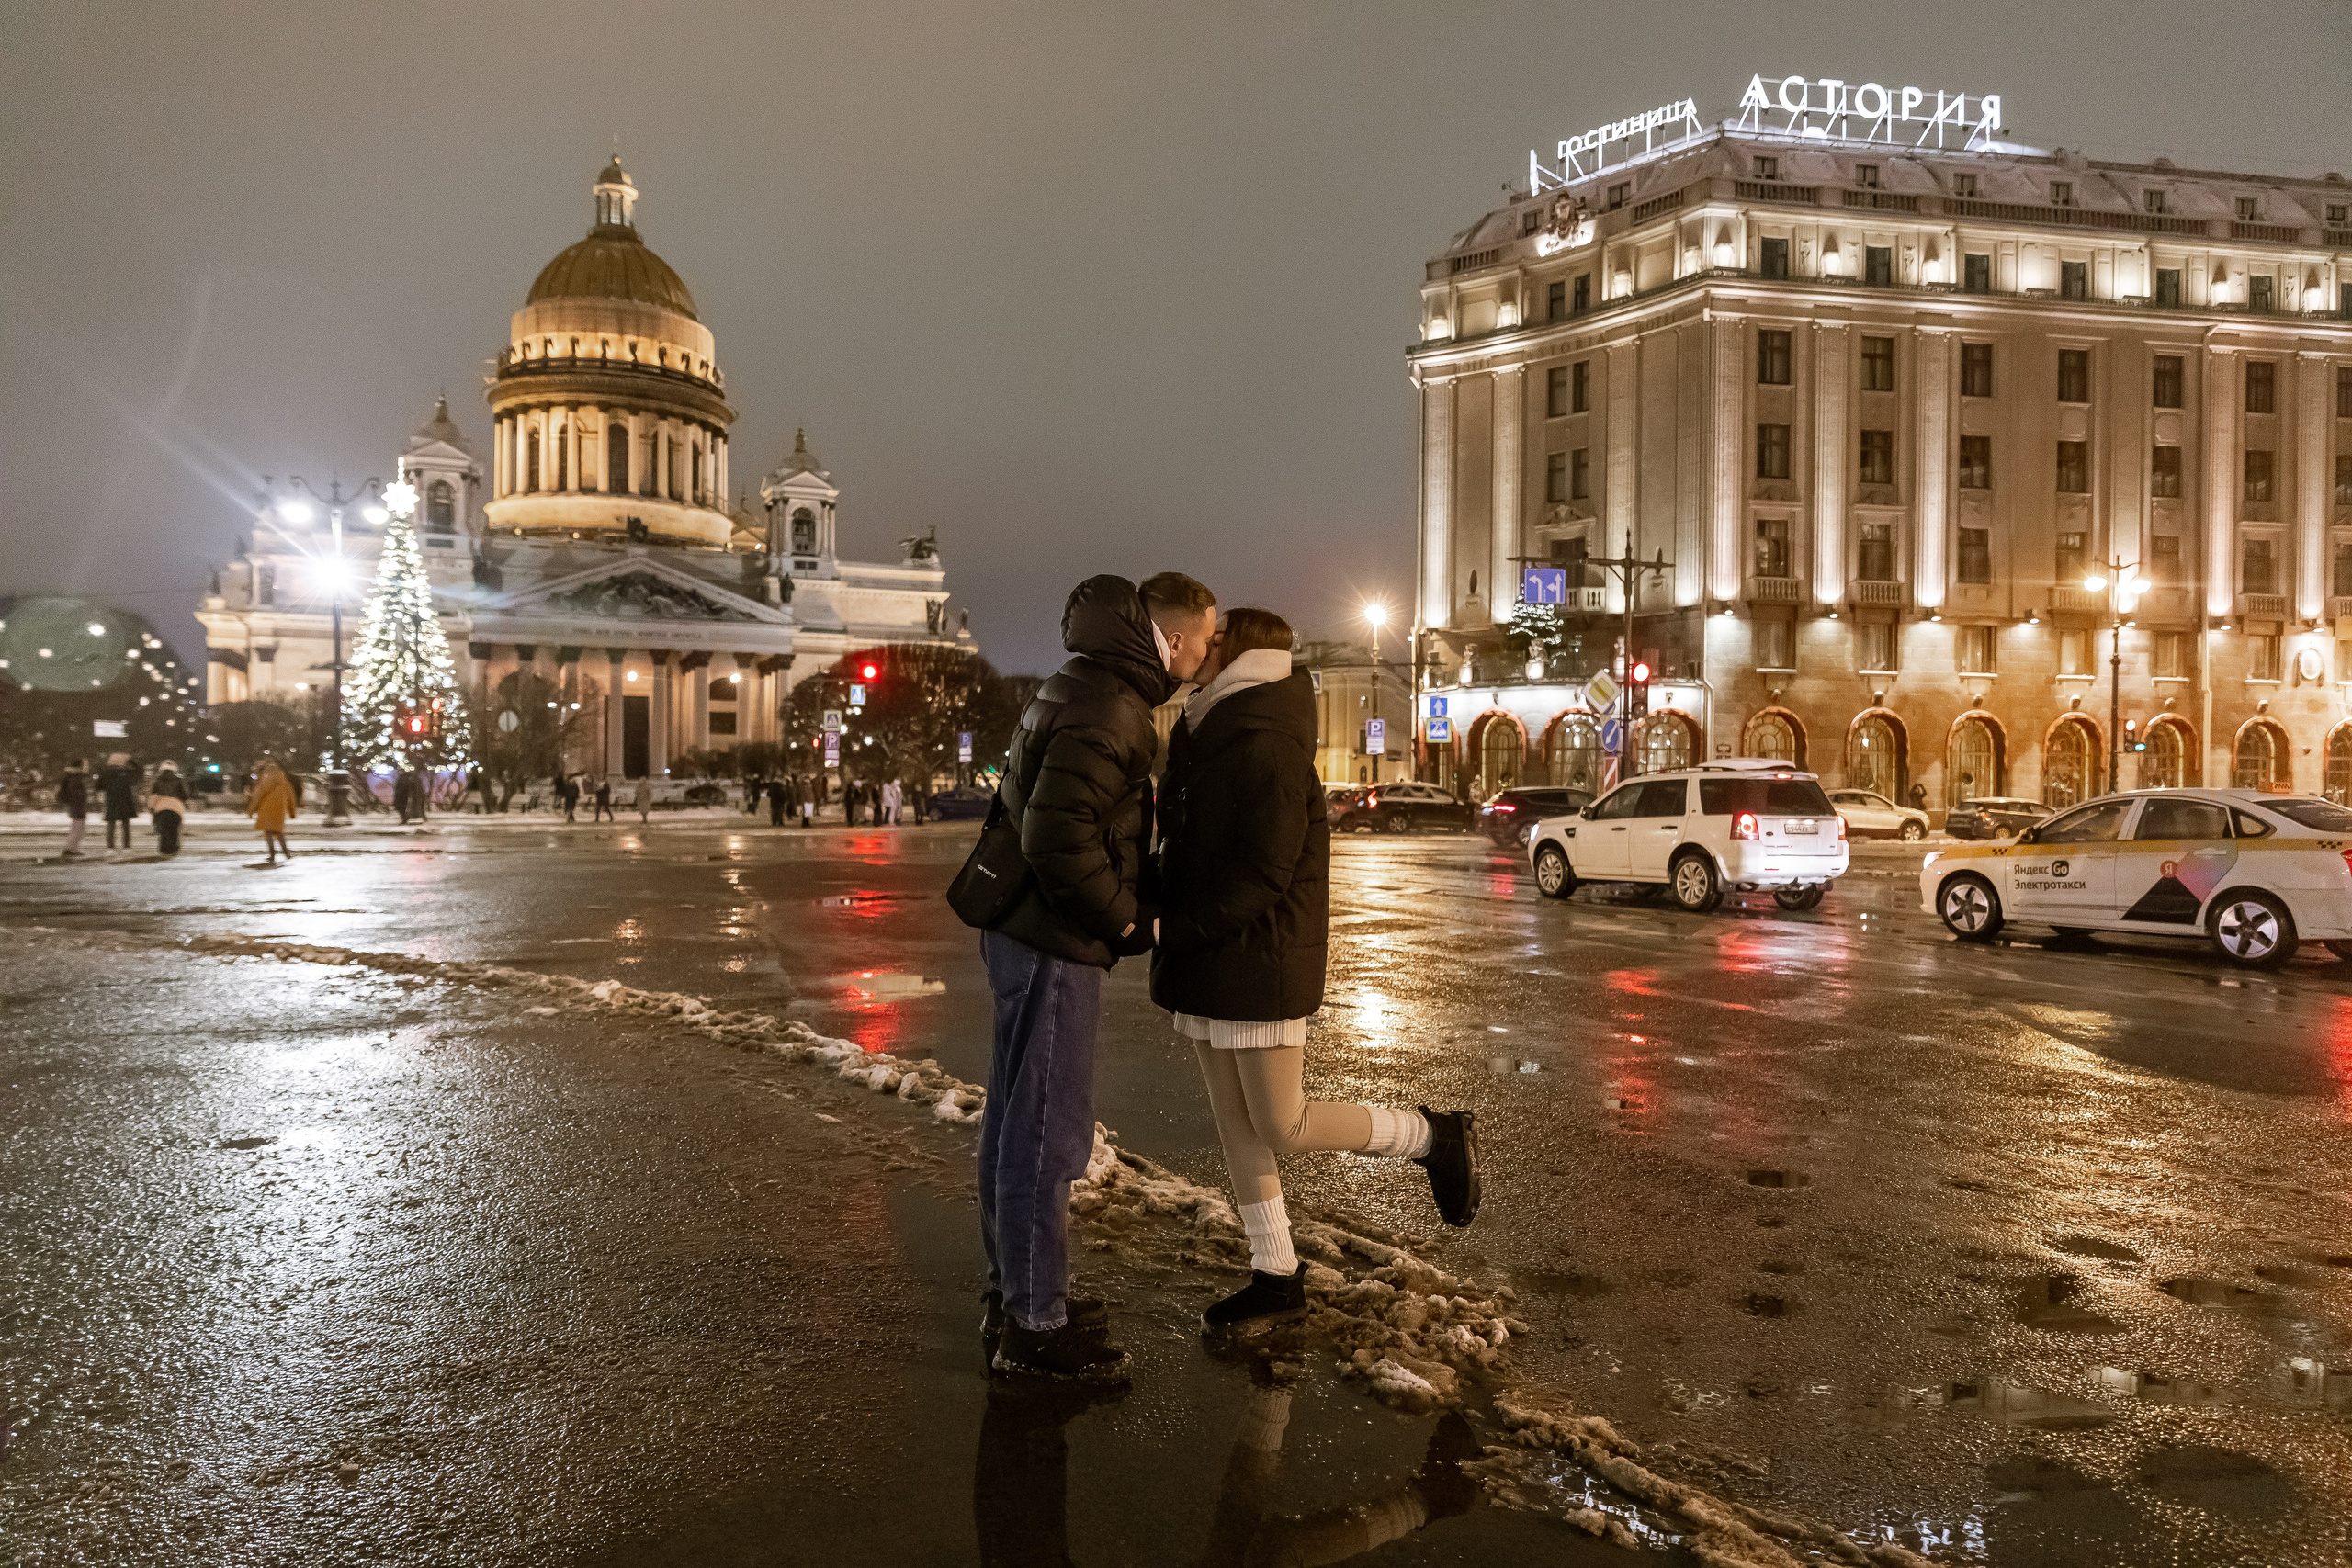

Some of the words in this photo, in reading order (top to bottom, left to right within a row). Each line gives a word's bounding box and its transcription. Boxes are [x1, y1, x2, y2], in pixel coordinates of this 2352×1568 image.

[1740, 73, 2001, 130] АСТОРИЯ
[1558, 97, 1697, 159] ГОСТИНИЦА
[1371, 722, 1381, 736] P
[828, 735, 837, 748] P
[2014, 864, 2049, 875] Яндекс
[2052, 863, 2068, 875] Go
[2014, 879, 2086, 891] Электротакси
